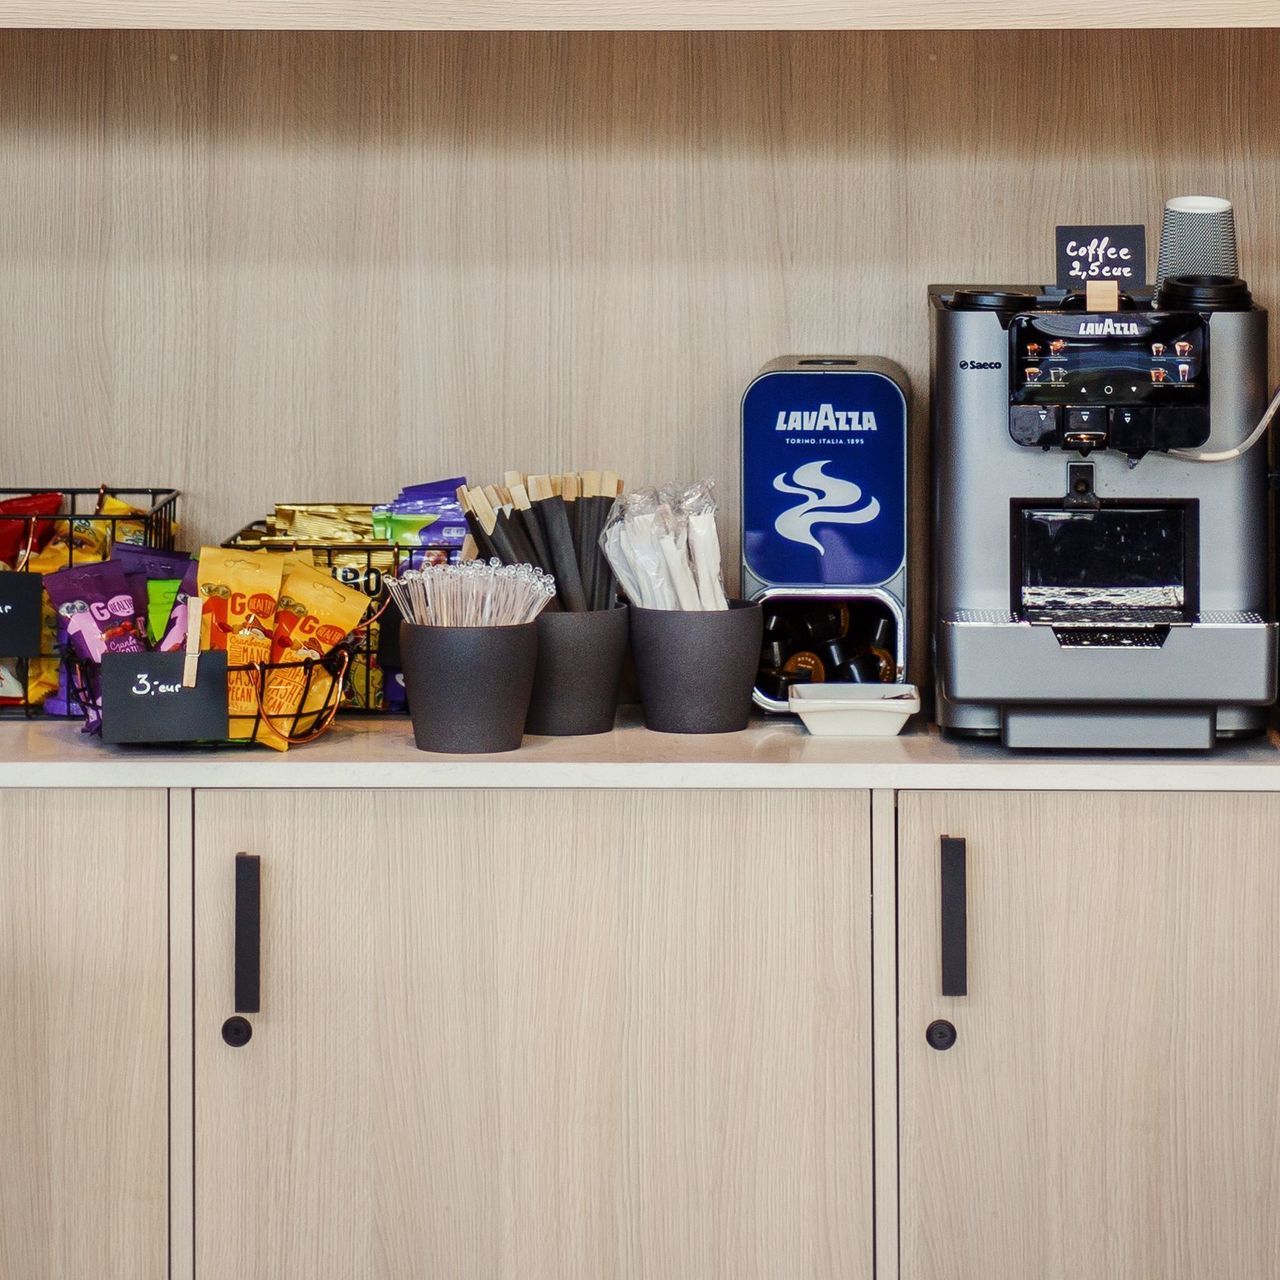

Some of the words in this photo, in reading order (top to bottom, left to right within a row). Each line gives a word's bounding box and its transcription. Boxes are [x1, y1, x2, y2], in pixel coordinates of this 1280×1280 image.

[1066, 236, 1132, 263] Coffee
[1079, 318, 1139, 335] LAVAZZA
[969, 360, 1002, 370] Saeco
[775, 403, 878, 431] LAVAZZA
